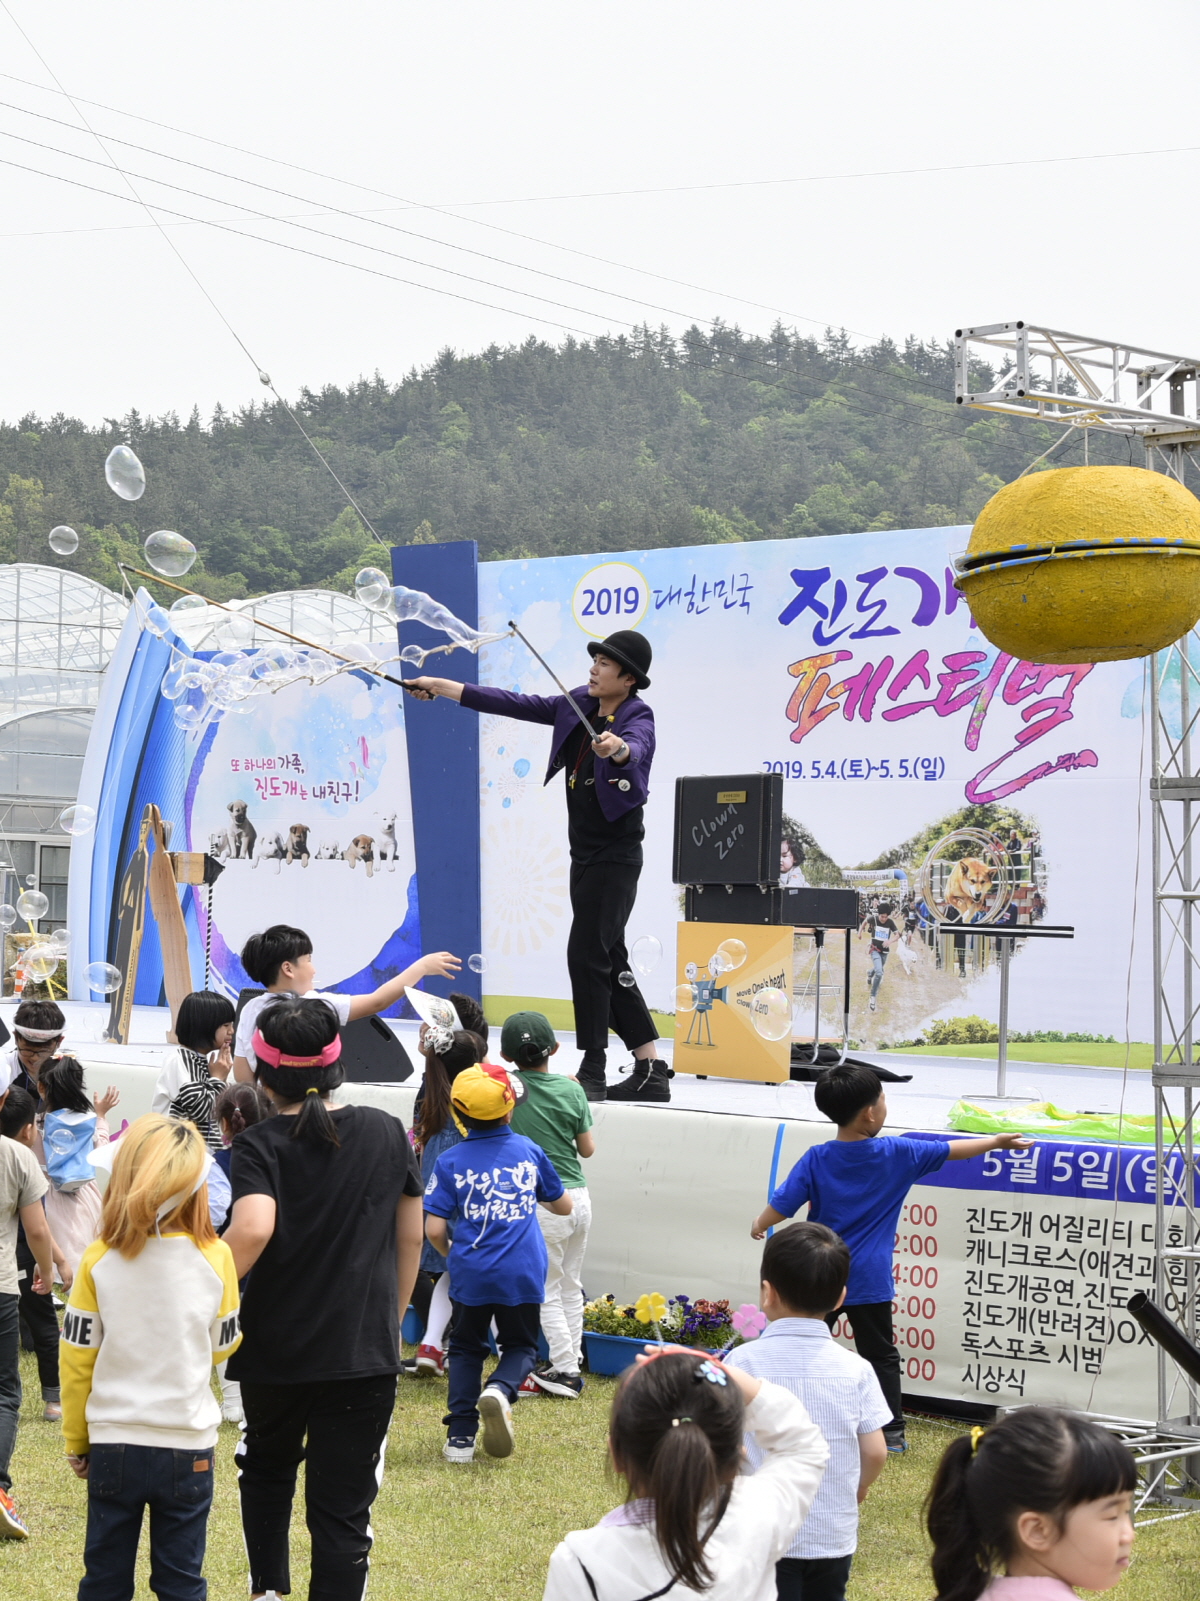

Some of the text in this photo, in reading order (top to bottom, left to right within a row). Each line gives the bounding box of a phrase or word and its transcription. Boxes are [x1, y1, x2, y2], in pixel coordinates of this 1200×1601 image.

[581, 571, 754, 616] 2019 대한민국
[786, 650, 1098, 805] 페스티벌
[230, 753, 305, 774] 또 하나의 가족,
[762, 760, 806, 779] 2019.
[254, 776, 359, 804] 진도개는 내친구!
[691, 803, 738, 847] Clown
[714, 823, 744, 860] Zero
[736, 988, 752, 998] Move
[769, 968, 787, 989] heart
[754, 1000, 769, 1015] Zero
[982, 1147, 1041, 1184] 5월
[1052, 1150, 1113, 1190] 5일
[966, 1207, 1033, 1239] 진도개
[1039, 1212, 1133, 1249] 어질리티
[961, 1331, 1103, 1375] 독스포츠 시범
[961, 1363, 1026, 1397] 시상식
